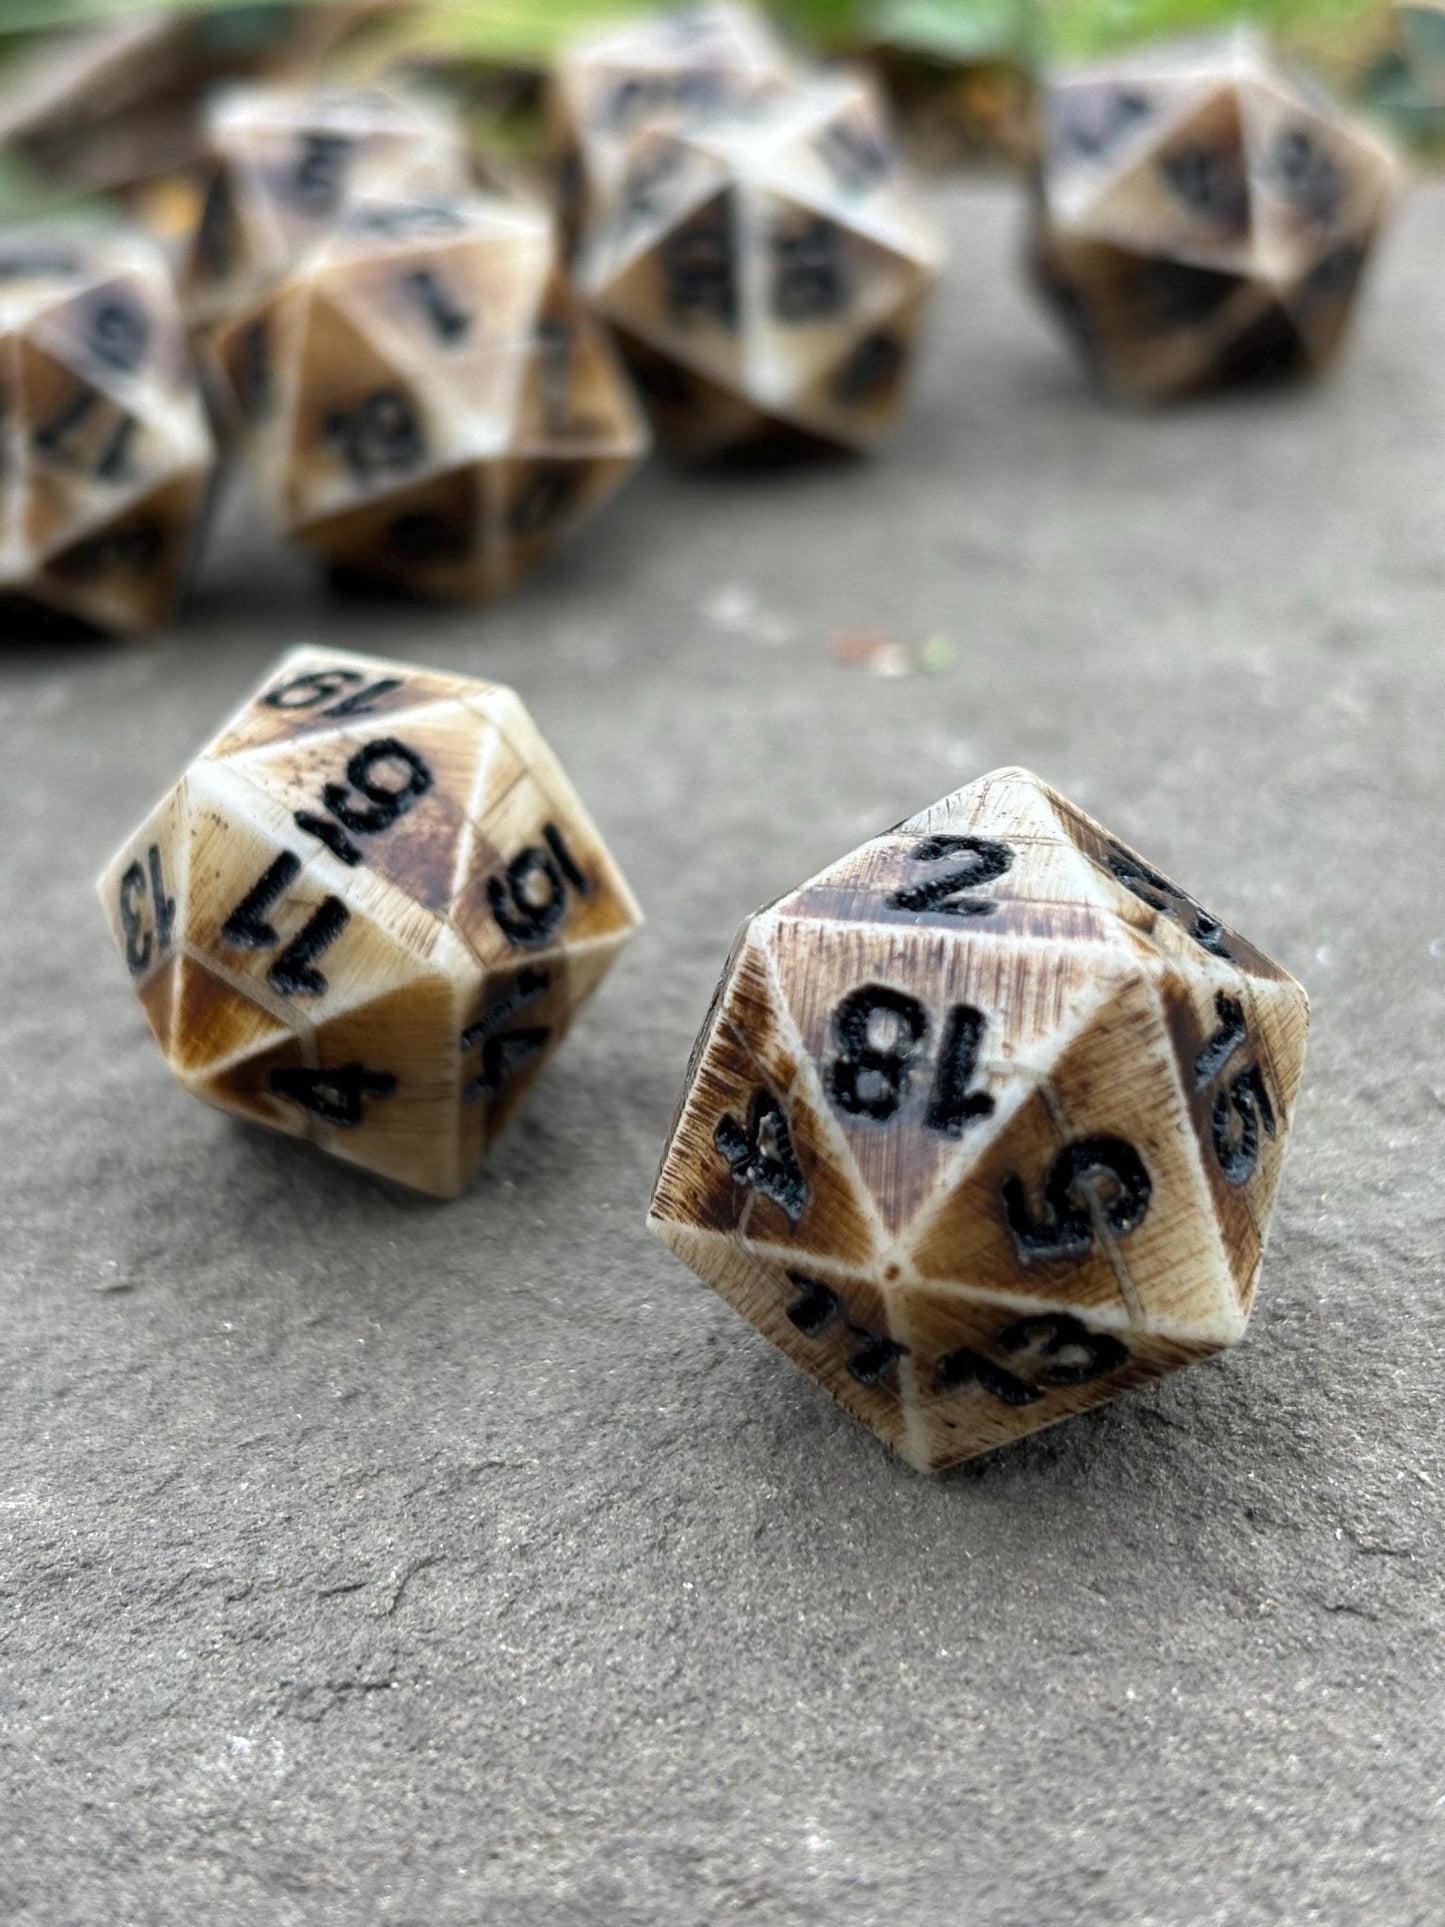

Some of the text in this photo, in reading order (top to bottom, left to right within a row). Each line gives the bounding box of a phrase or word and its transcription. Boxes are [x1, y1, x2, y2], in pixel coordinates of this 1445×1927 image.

[261, 669, 403, 717] 19
[119, 844, 177, 977] 13
[220, 849, 352, 998] 11
[884, 834, 1015, 916] 2
[268, 1063, 397, 1128] 4
[823, 981, 997, 1139] 18
[713, 1086, 809, 1222] 4
[1002, 1132, 1152, 1265] 5
[934, 1311, 1130, 1407] 13
